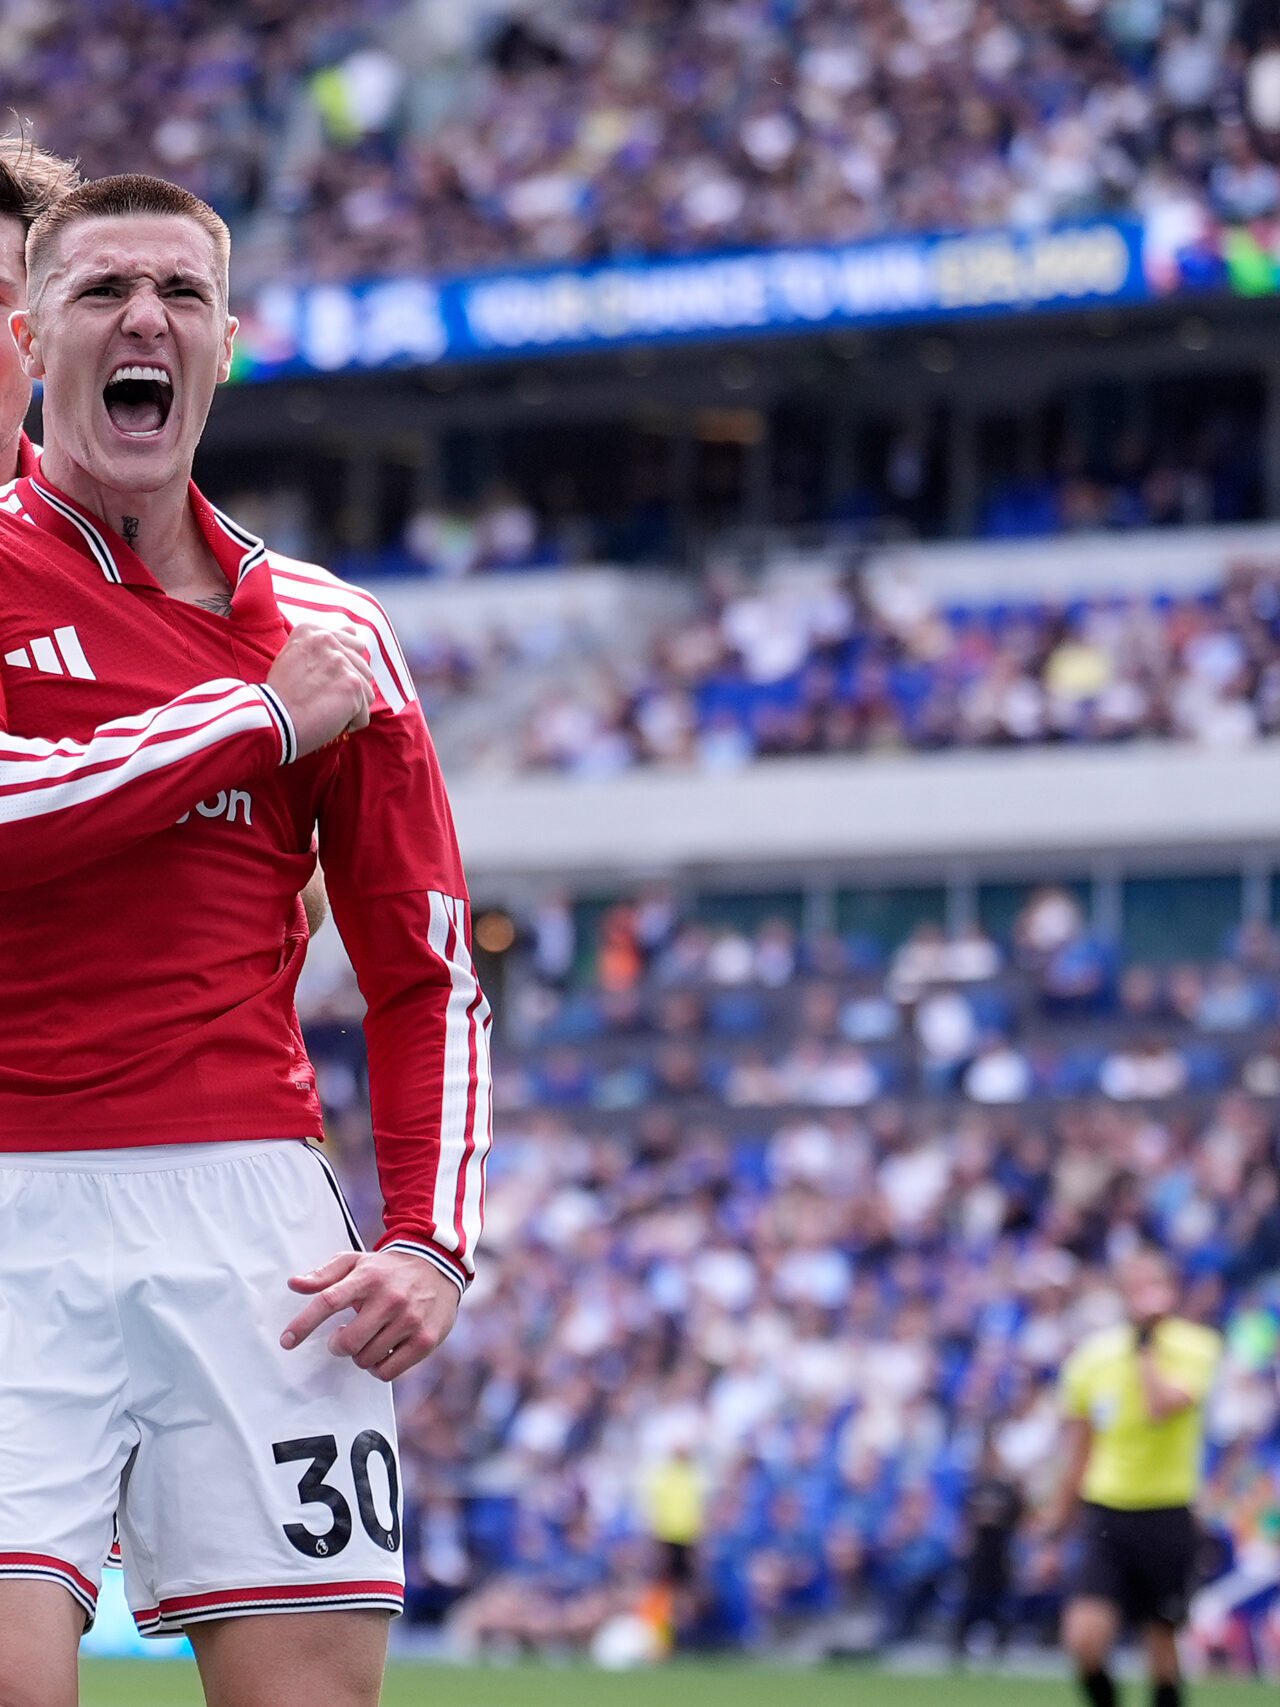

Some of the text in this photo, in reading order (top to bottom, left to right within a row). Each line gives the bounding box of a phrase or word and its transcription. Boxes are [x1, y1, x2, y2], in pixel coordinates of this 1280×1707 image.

[774, 250, 836, 320] TO
[840, 242, 923, 316] WIN
[272, 1429, 401, 1558] 30
